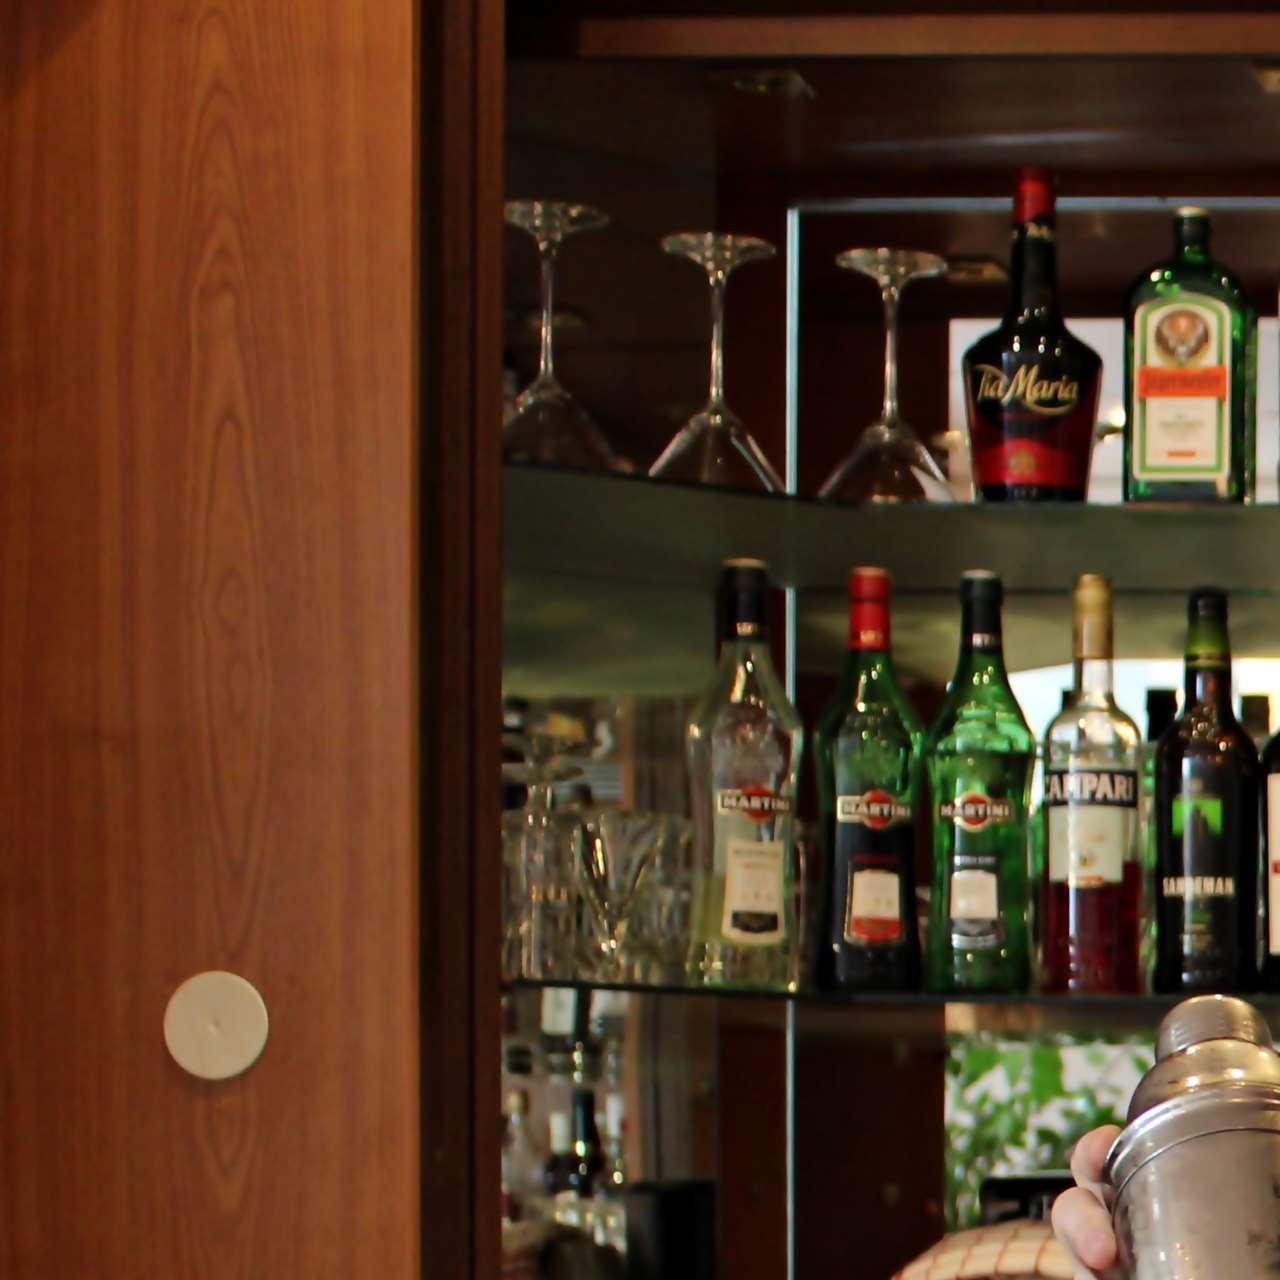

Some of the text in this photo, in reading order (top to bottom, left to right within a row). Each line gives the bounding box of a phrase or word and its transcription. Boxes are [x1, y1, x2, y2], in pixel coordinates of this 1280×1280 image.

[975, 364, 1079, 414] Tia Maria
[1046, 774, 1134, 801] AMPARI
[723, 796, 790, 811] MARTINI
[842, 802, 911, 816] MARTINI
[940, 803, 1009, 817] MARTINI
